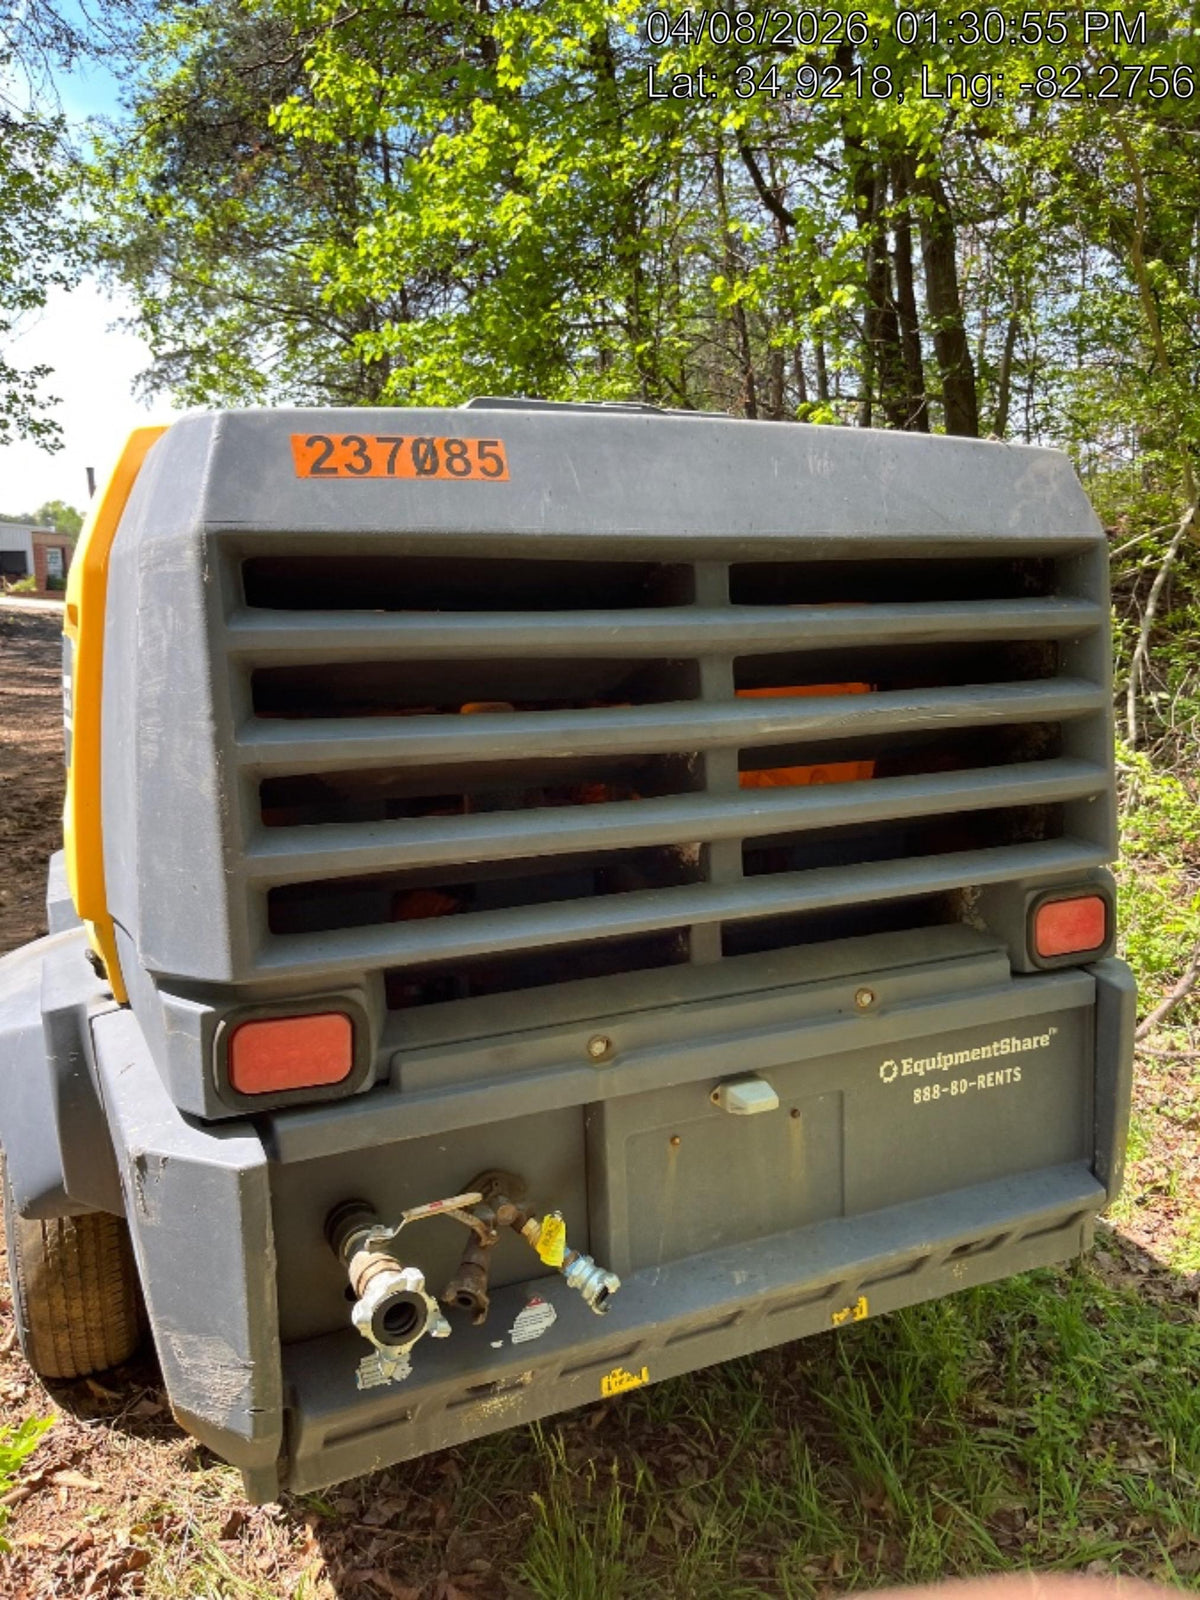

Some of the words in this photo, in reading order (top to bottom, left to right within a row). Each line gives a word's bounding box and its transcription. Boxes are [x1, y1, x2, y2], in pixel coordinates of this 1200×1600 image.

[305, 434, 504, 478] 237085
[901, 1033, 1050, 1077] EquipmentShare
[913, 1066, 1022, 1105] 888-80-RENTS
